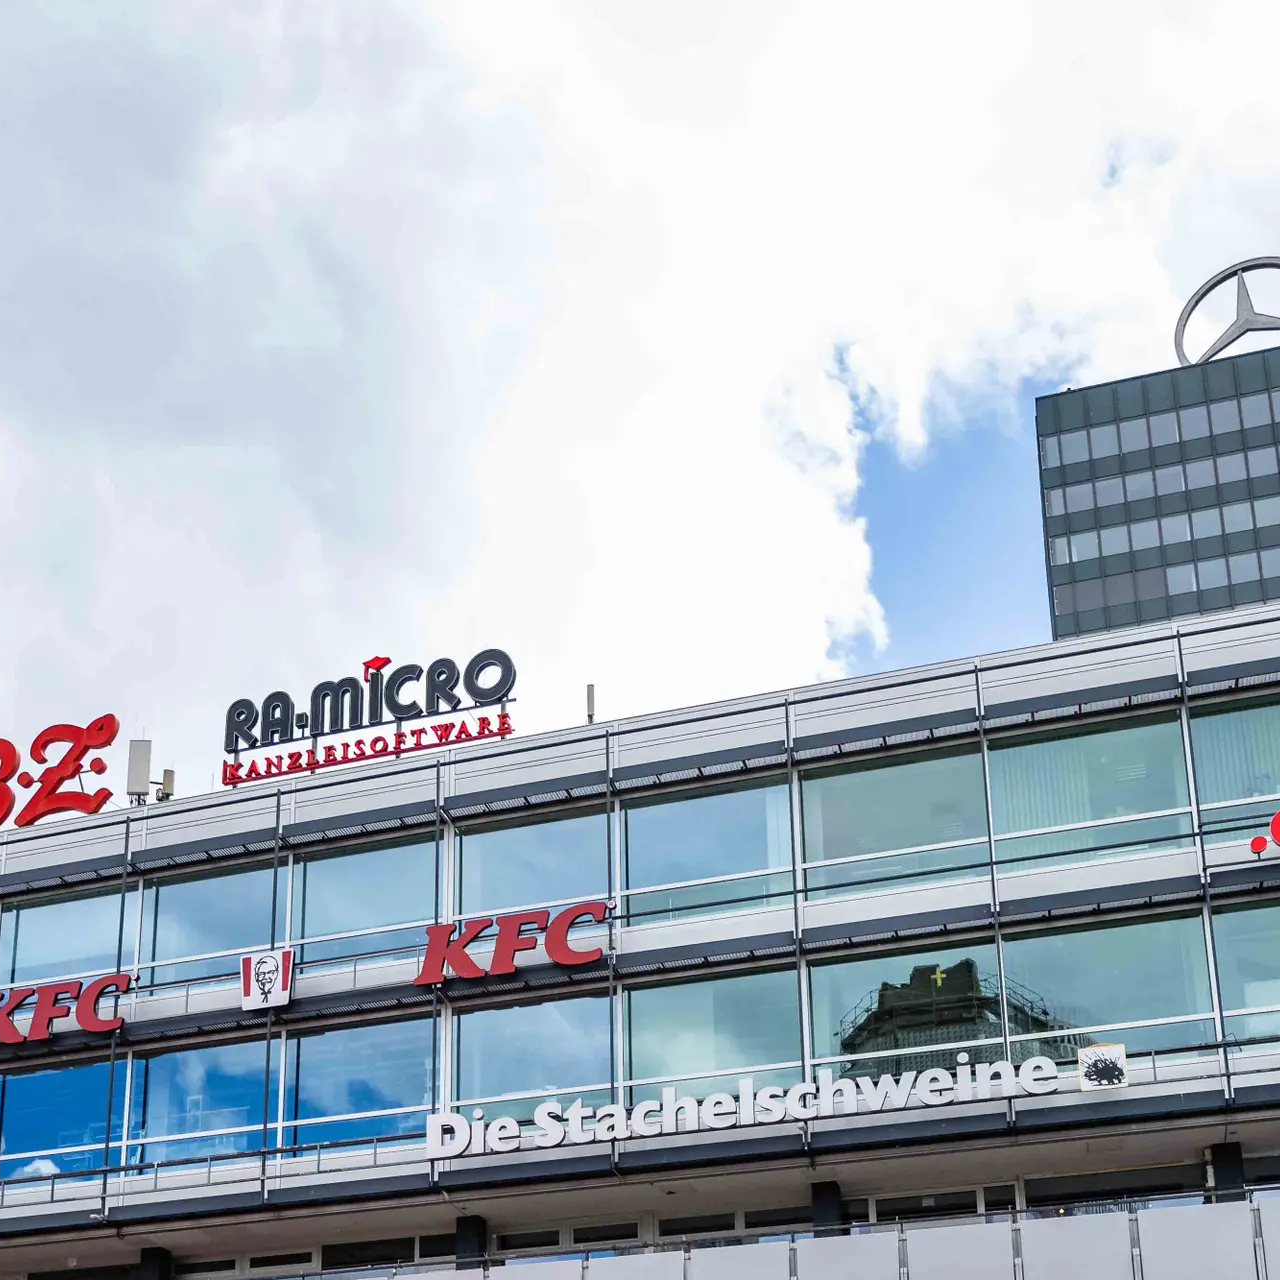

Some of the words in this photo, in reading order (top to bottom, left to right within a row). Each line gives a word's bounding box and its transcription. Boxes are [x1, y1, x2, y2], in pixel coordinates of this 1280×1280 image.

[225, 713, 513, 782] KANZLEISOFTWARE
[414, 901, 608, 986] KFC
[425, 1107, 521, 1160] Die
[532, 1051, 1060, 1149] Stachelschweine
